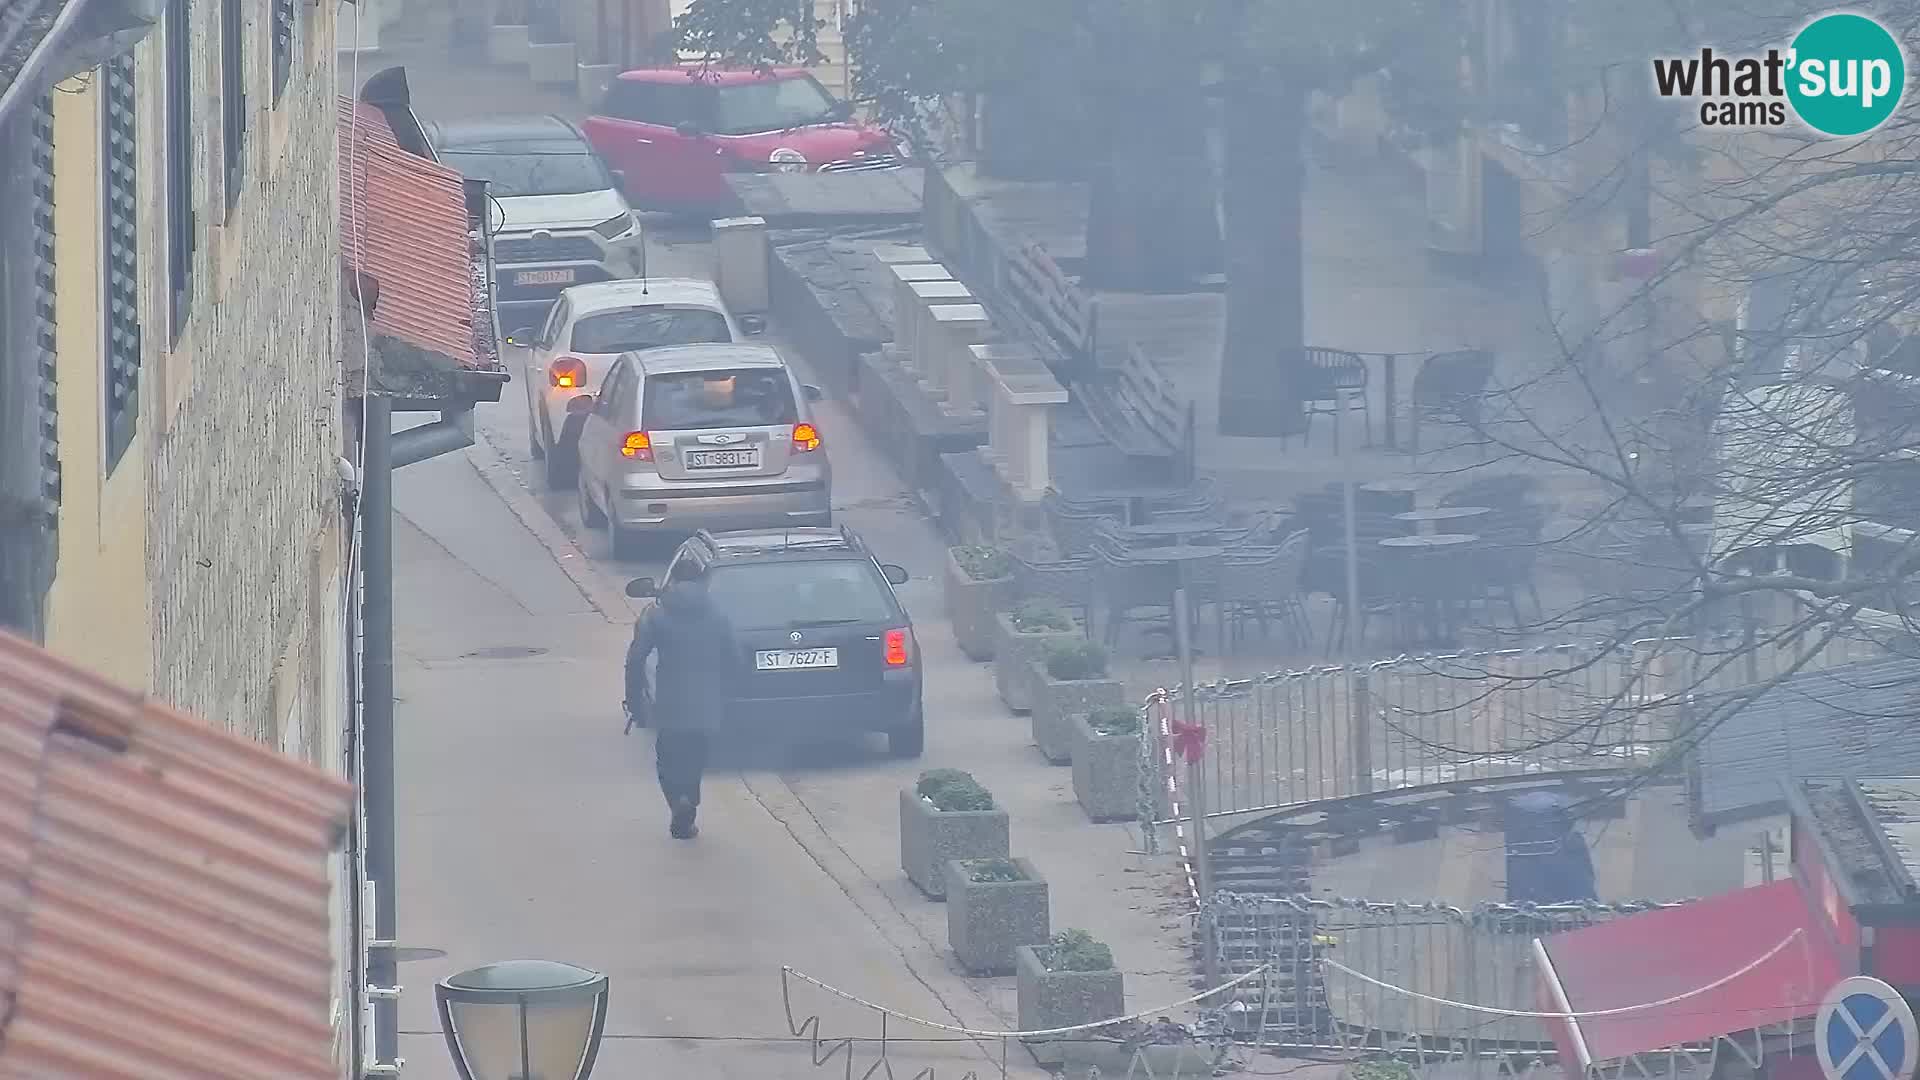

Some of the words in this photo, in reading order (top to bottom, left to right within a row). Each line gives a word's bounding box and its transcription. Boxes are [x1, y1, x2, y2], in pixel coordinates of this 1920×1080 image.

[695, 454, 708, 466] ST
[766, 653, 780, 667] ST
[789, 651, 831, 666] 7627-F
